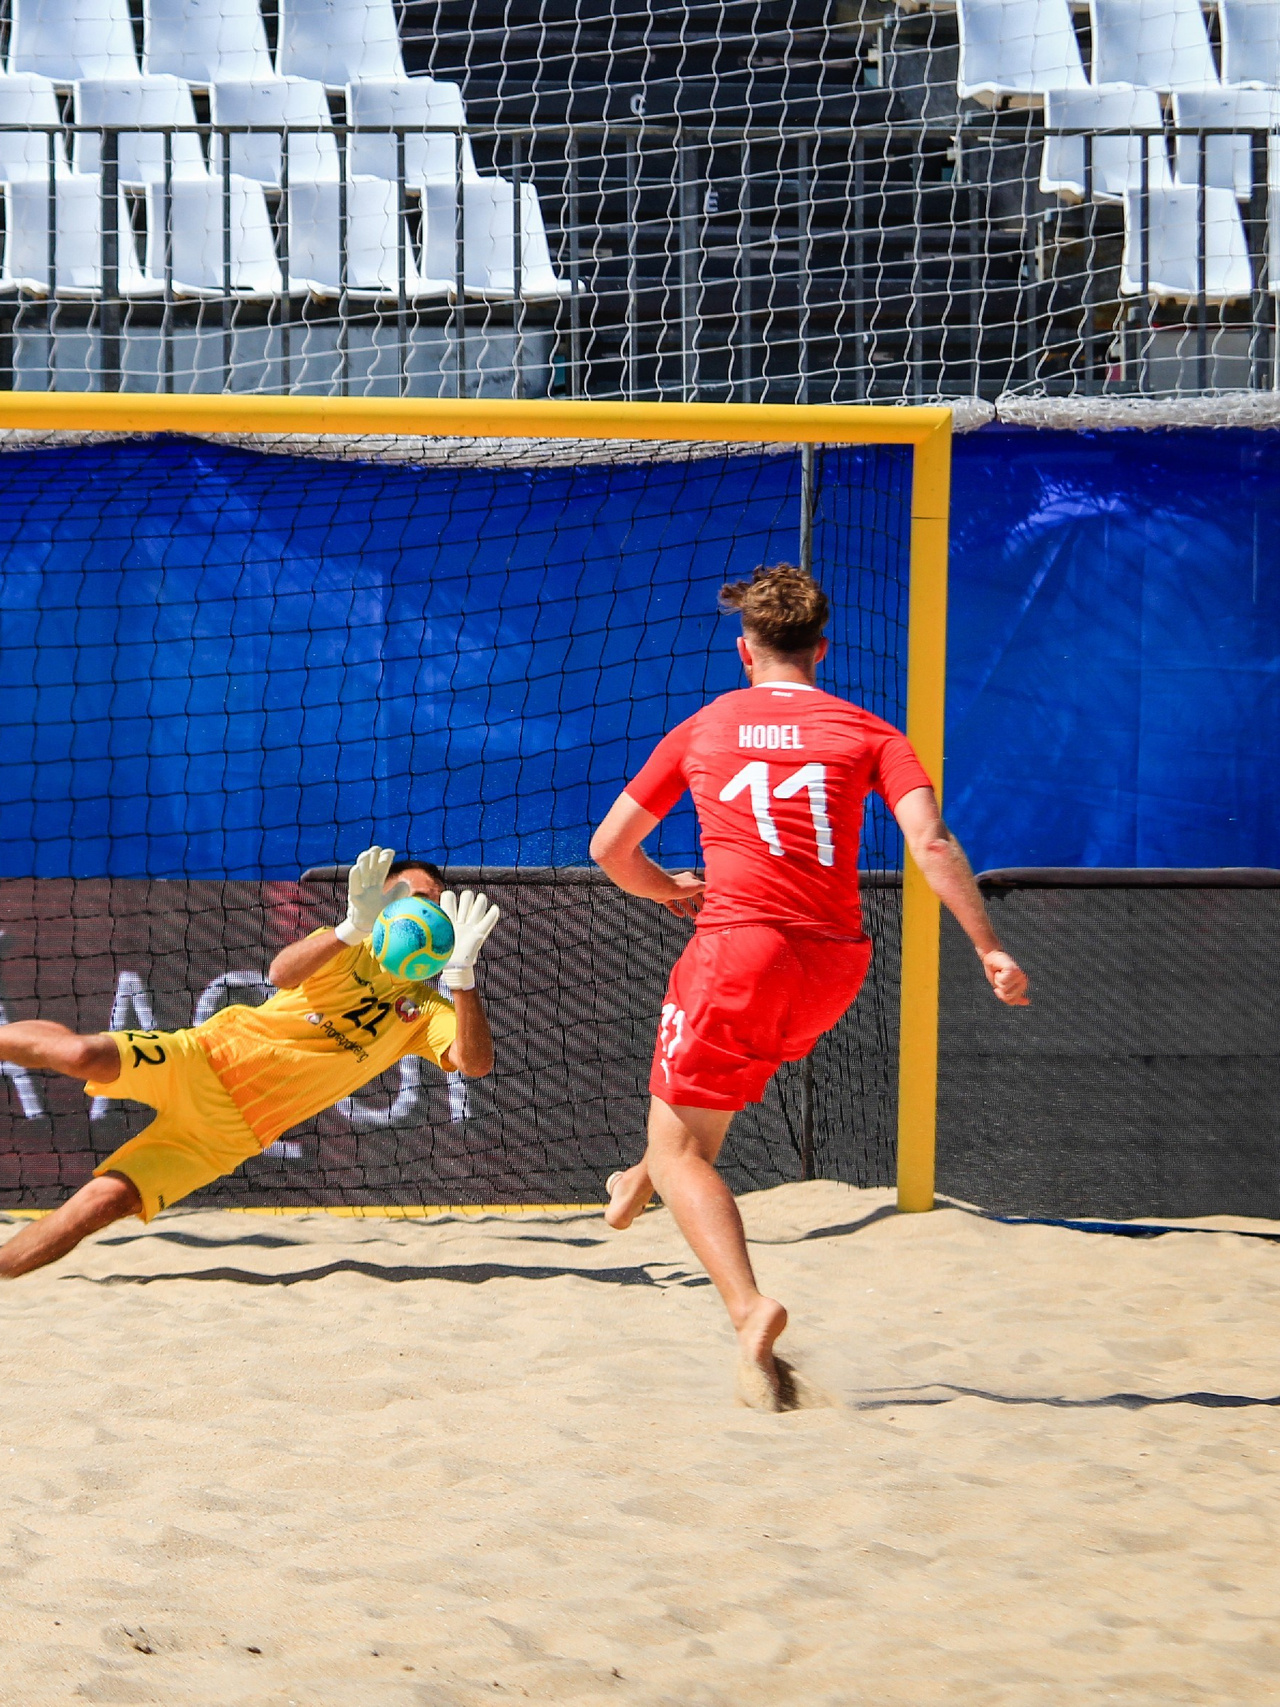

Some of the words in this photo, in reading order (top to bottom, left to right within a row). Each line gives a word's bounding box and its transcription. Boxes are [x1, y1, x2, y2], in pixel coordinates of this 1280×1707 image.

[738, 725, 805, 750] HODEL
[719, 761, 836, 867] 11
[341, 997, 391, 1038] 22
[124, 1031, 166, 1069] 22
